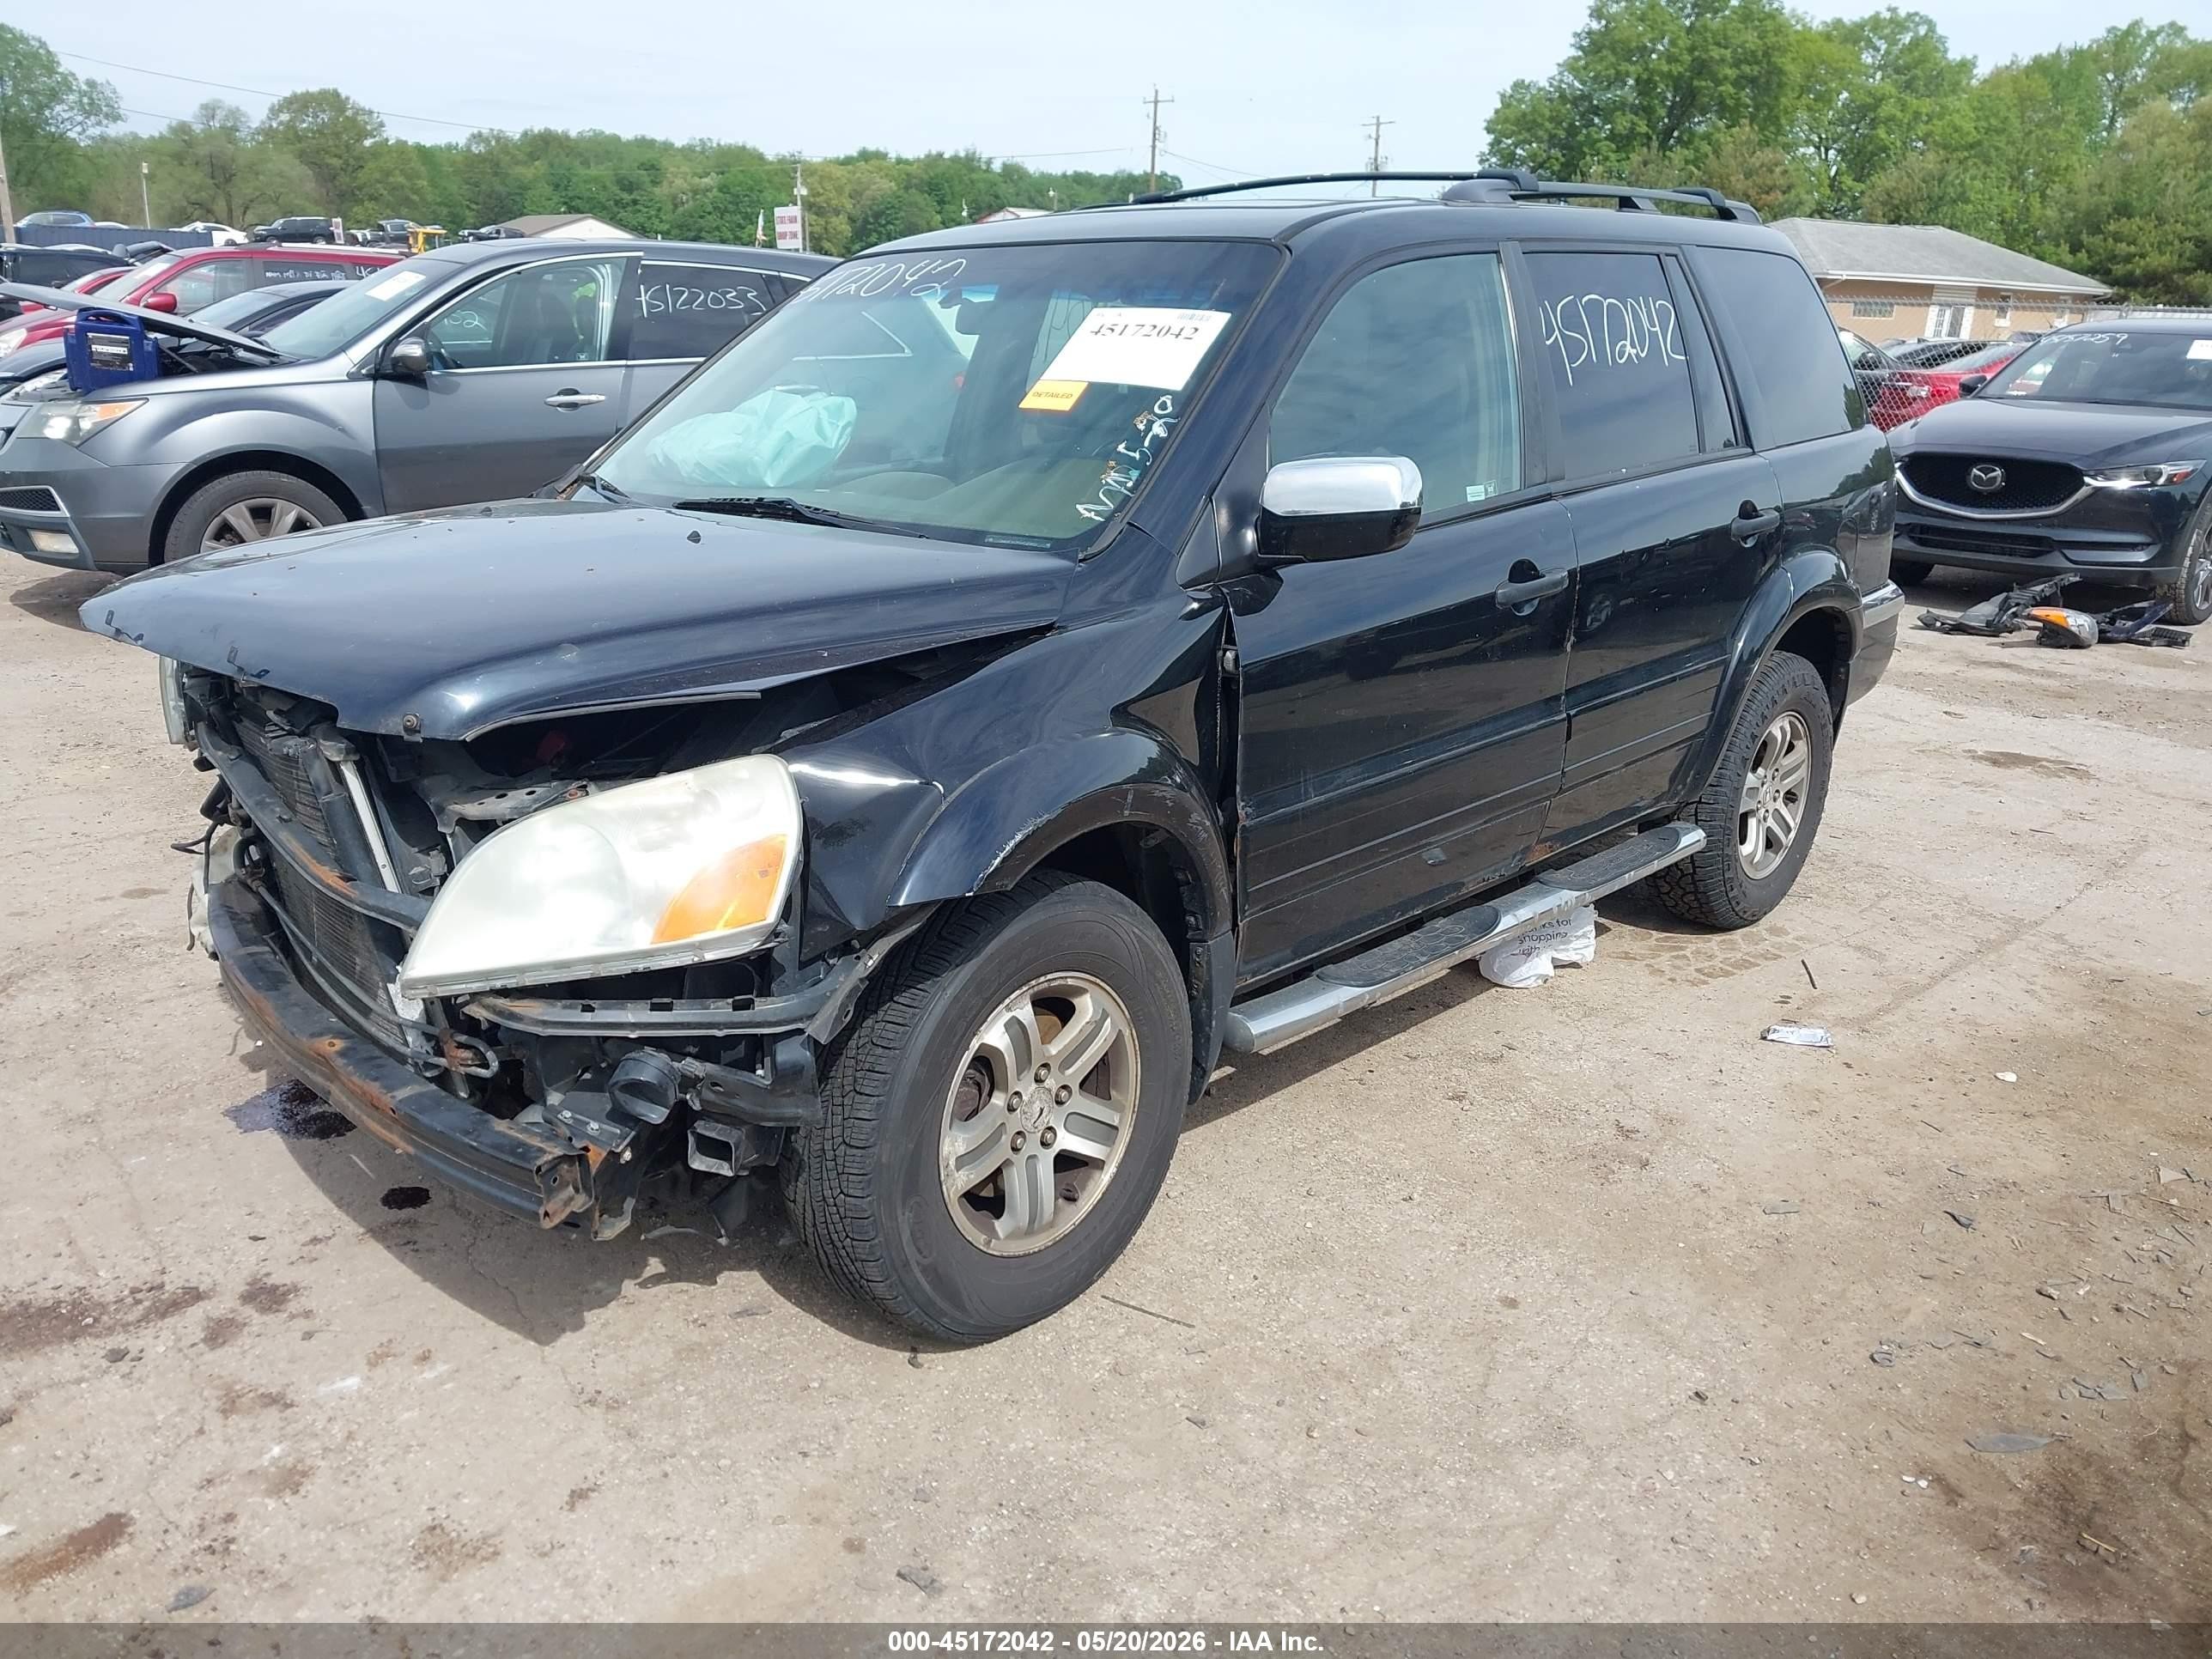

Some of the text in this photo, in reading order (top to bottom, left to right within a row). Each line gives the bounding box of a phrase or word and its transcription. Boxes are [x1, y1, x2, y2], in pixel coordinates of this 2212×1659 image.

[1090, 323, 1200, 340] 45172042
[1539, 294, 1689, 386] 45172042
[1031, 391, 1073, 399] DETAILED
